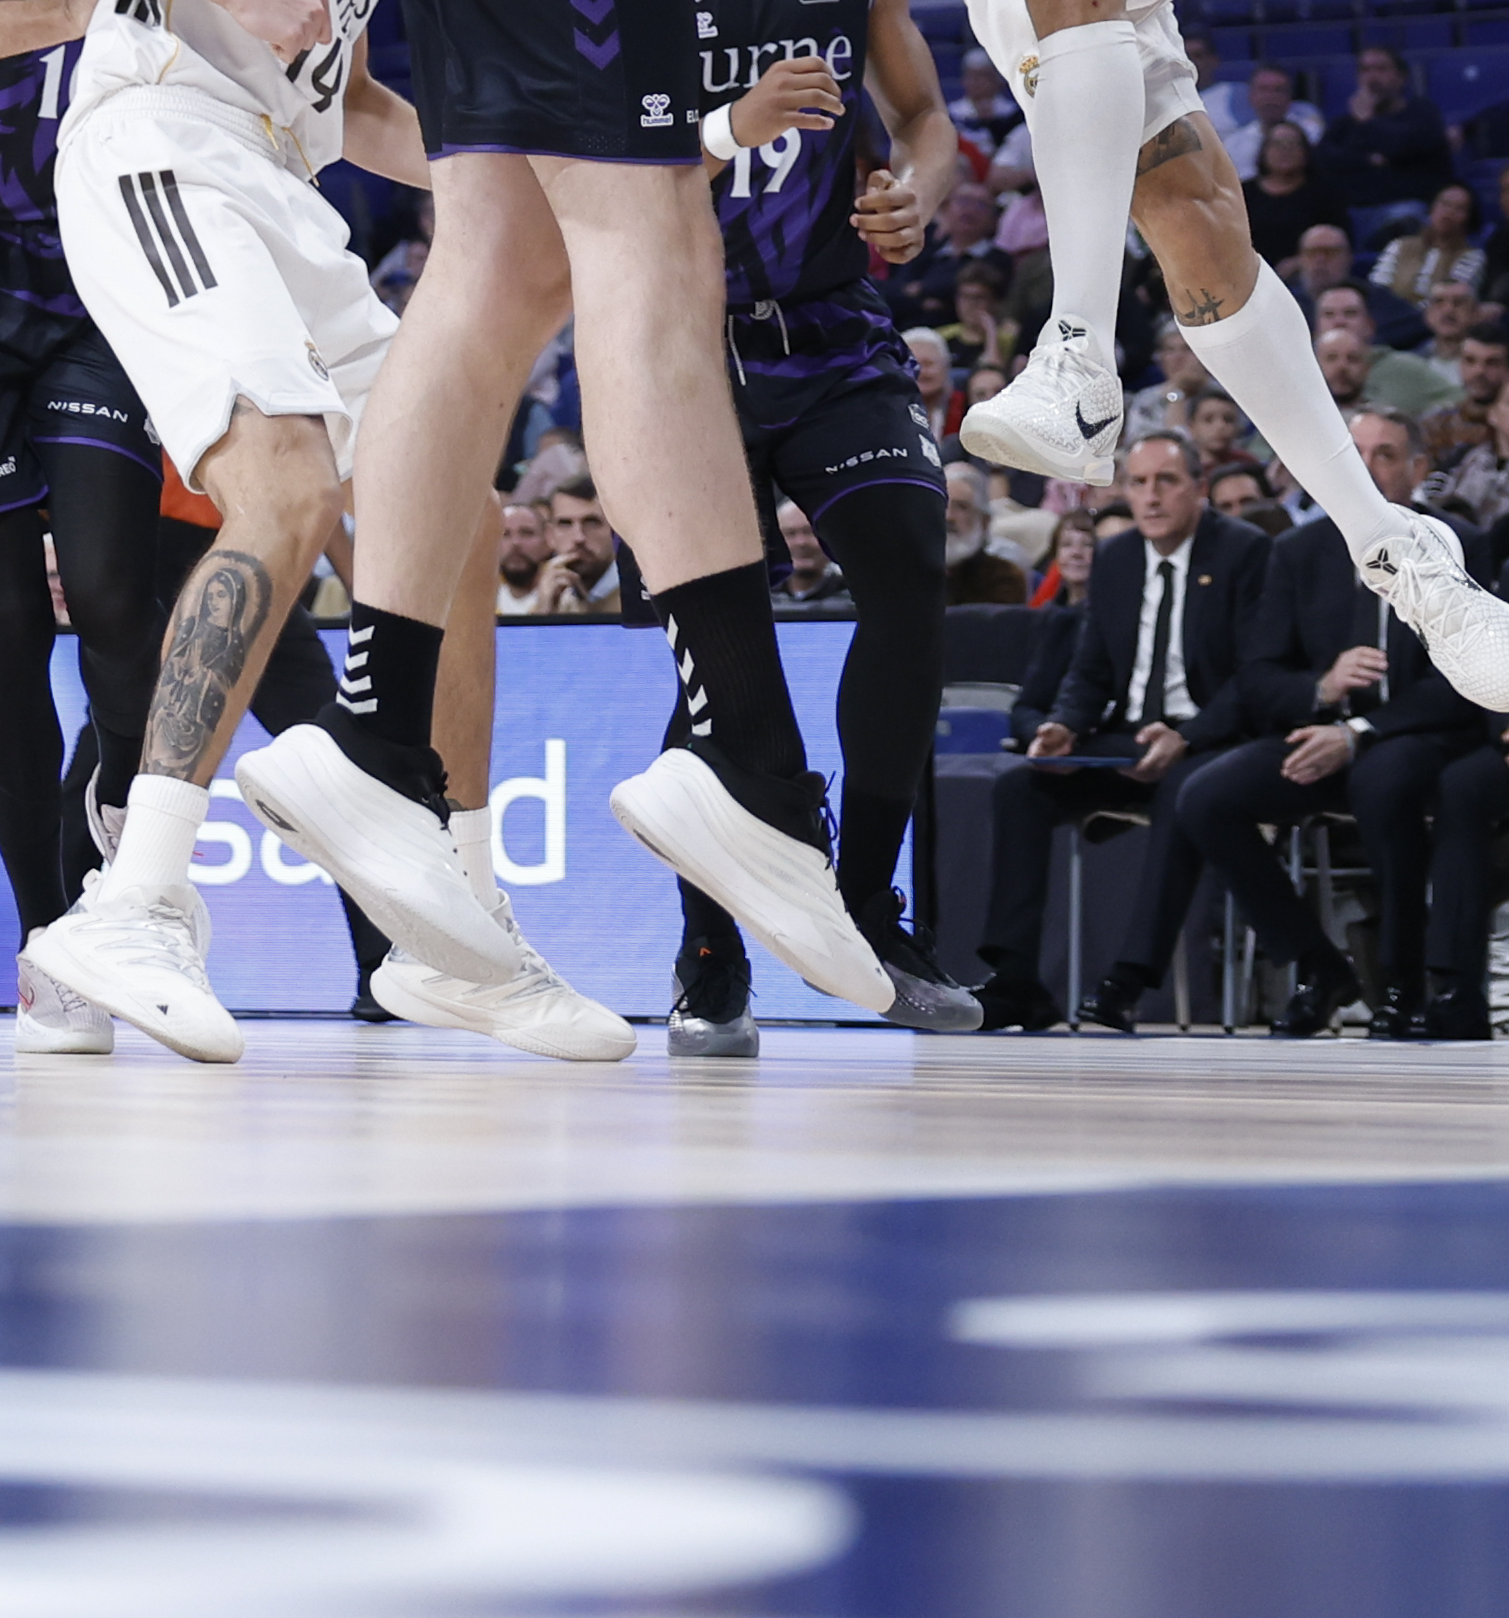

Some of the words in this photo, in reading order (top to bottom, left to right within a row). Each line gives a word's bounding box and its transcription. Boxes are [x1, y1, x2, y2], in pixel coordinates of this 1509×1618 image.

[698, 32, 853, 94] urne
[729, 125, 803, 199] 19
[47, 399, 129, 424] NISSAN
[824, 447, 909, 475] NISSAN
